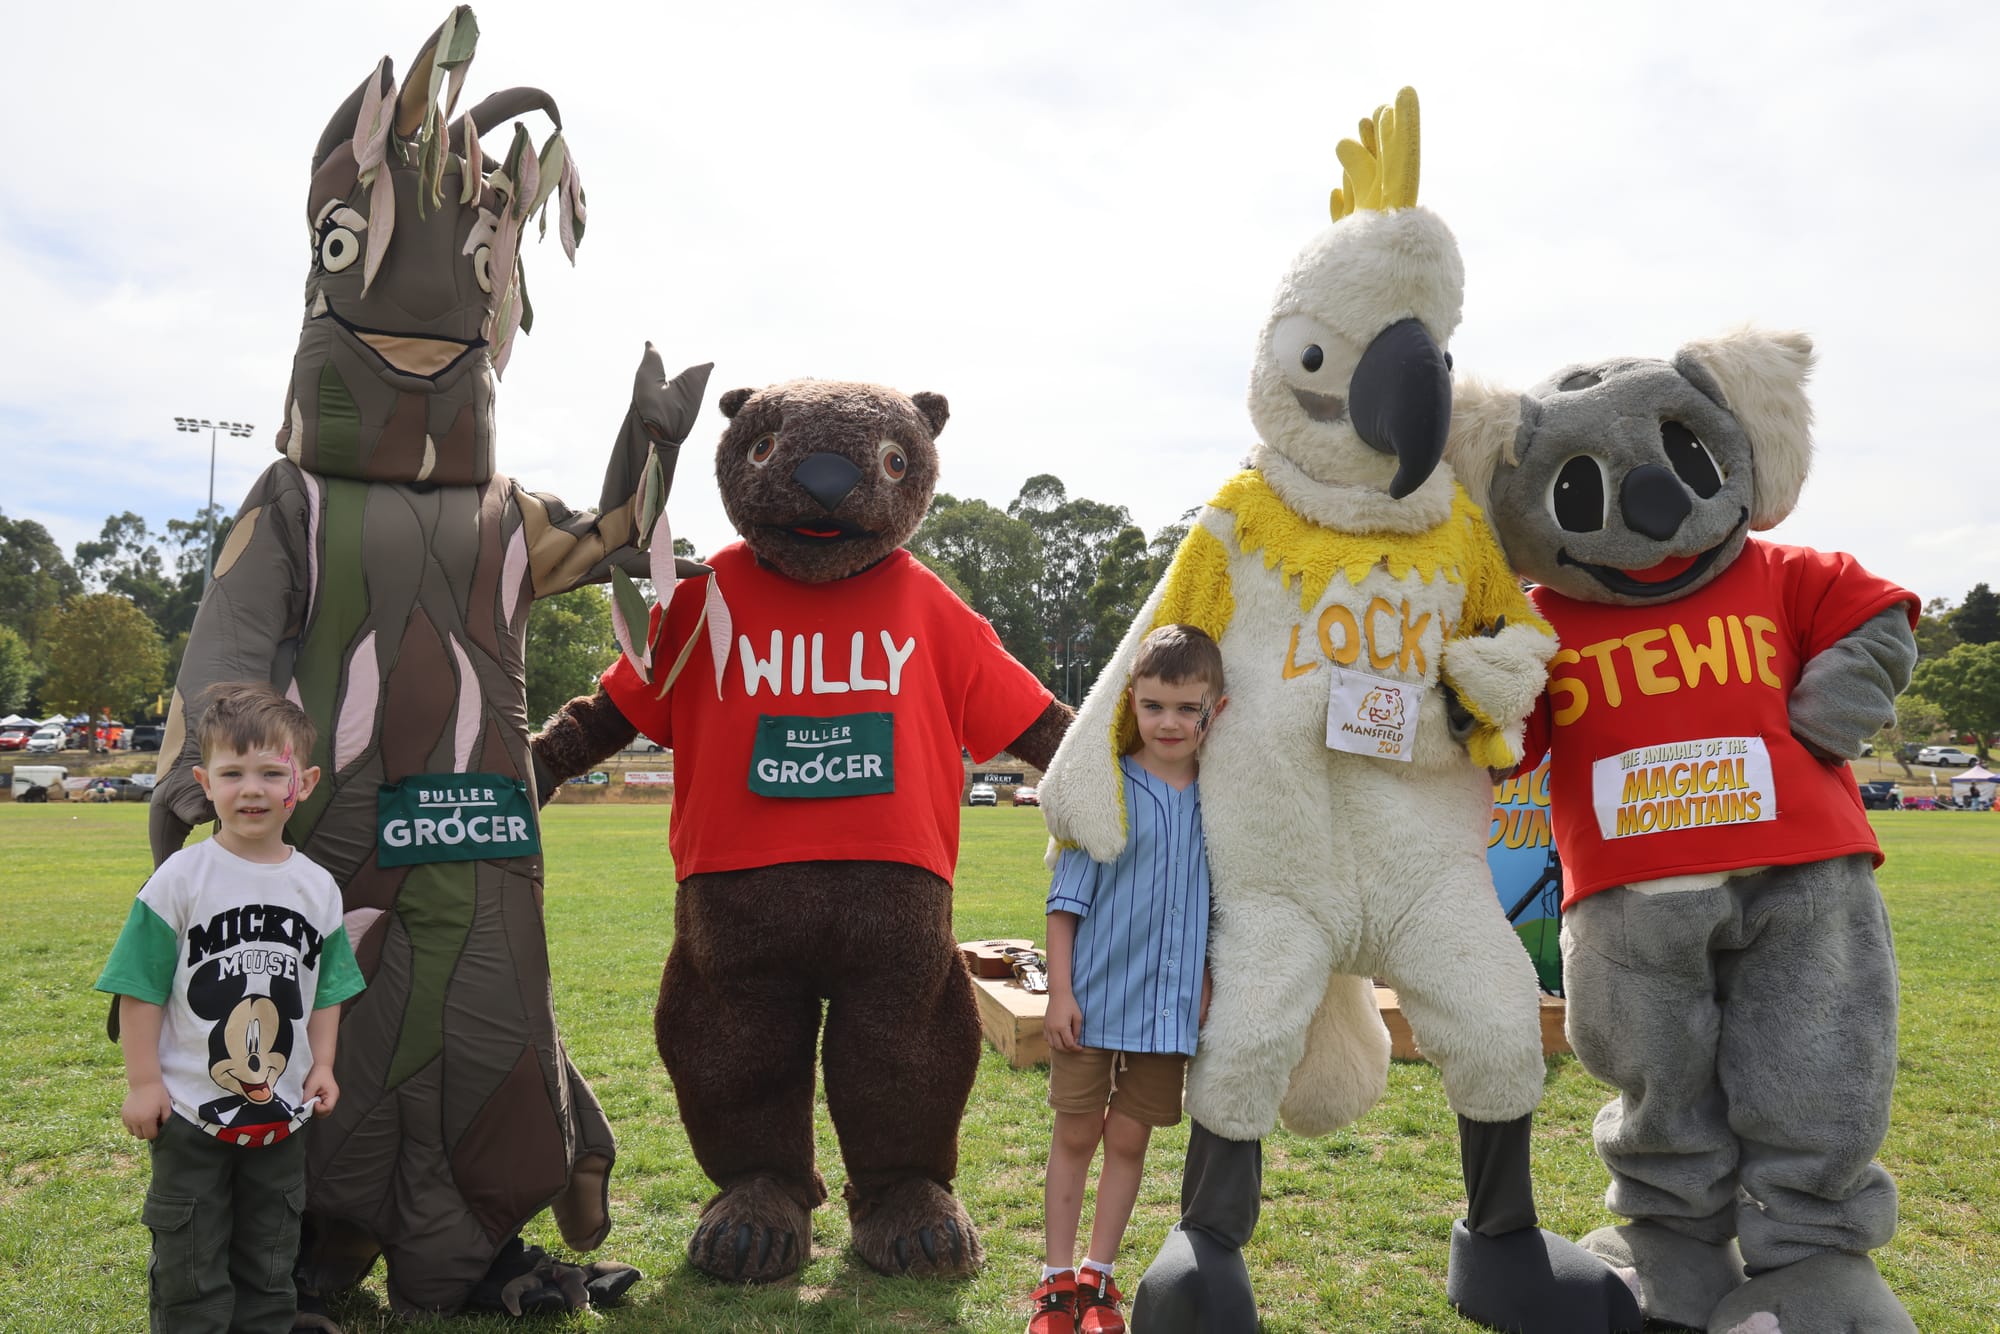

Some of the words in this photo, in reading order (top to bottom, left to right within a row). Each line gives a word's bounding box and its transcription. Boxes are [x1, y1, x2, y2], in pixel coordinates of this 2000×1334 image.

[738, 629, 916, 697] WILLY
[1548, 615, 1782, 726] STEWIE
[787, 726, 851, 742] BULLER
[1341, 722, 1404, 743] MANSFIELD
[1377, 741, 1401, 755] ZOO
[757, 752, 883, 784] GROCER
[1620, 751, 1641, 770] THE
[1642, 743, 1702, 765] ANIMALS
[1705, 740, 1723, 757] OF
[1725, 739, 1748, 755] THE
[418, 788, 495, 803] BULLER
[1621, 757, 1750, 804] MAGICAL
[383, 806, 529, 847] GROCER
[1616, 791, 1762, 837] MOUNTAINS
[181, 904, 324, 972] MICKEY
[218, 949, 297, 982] MOUSE
